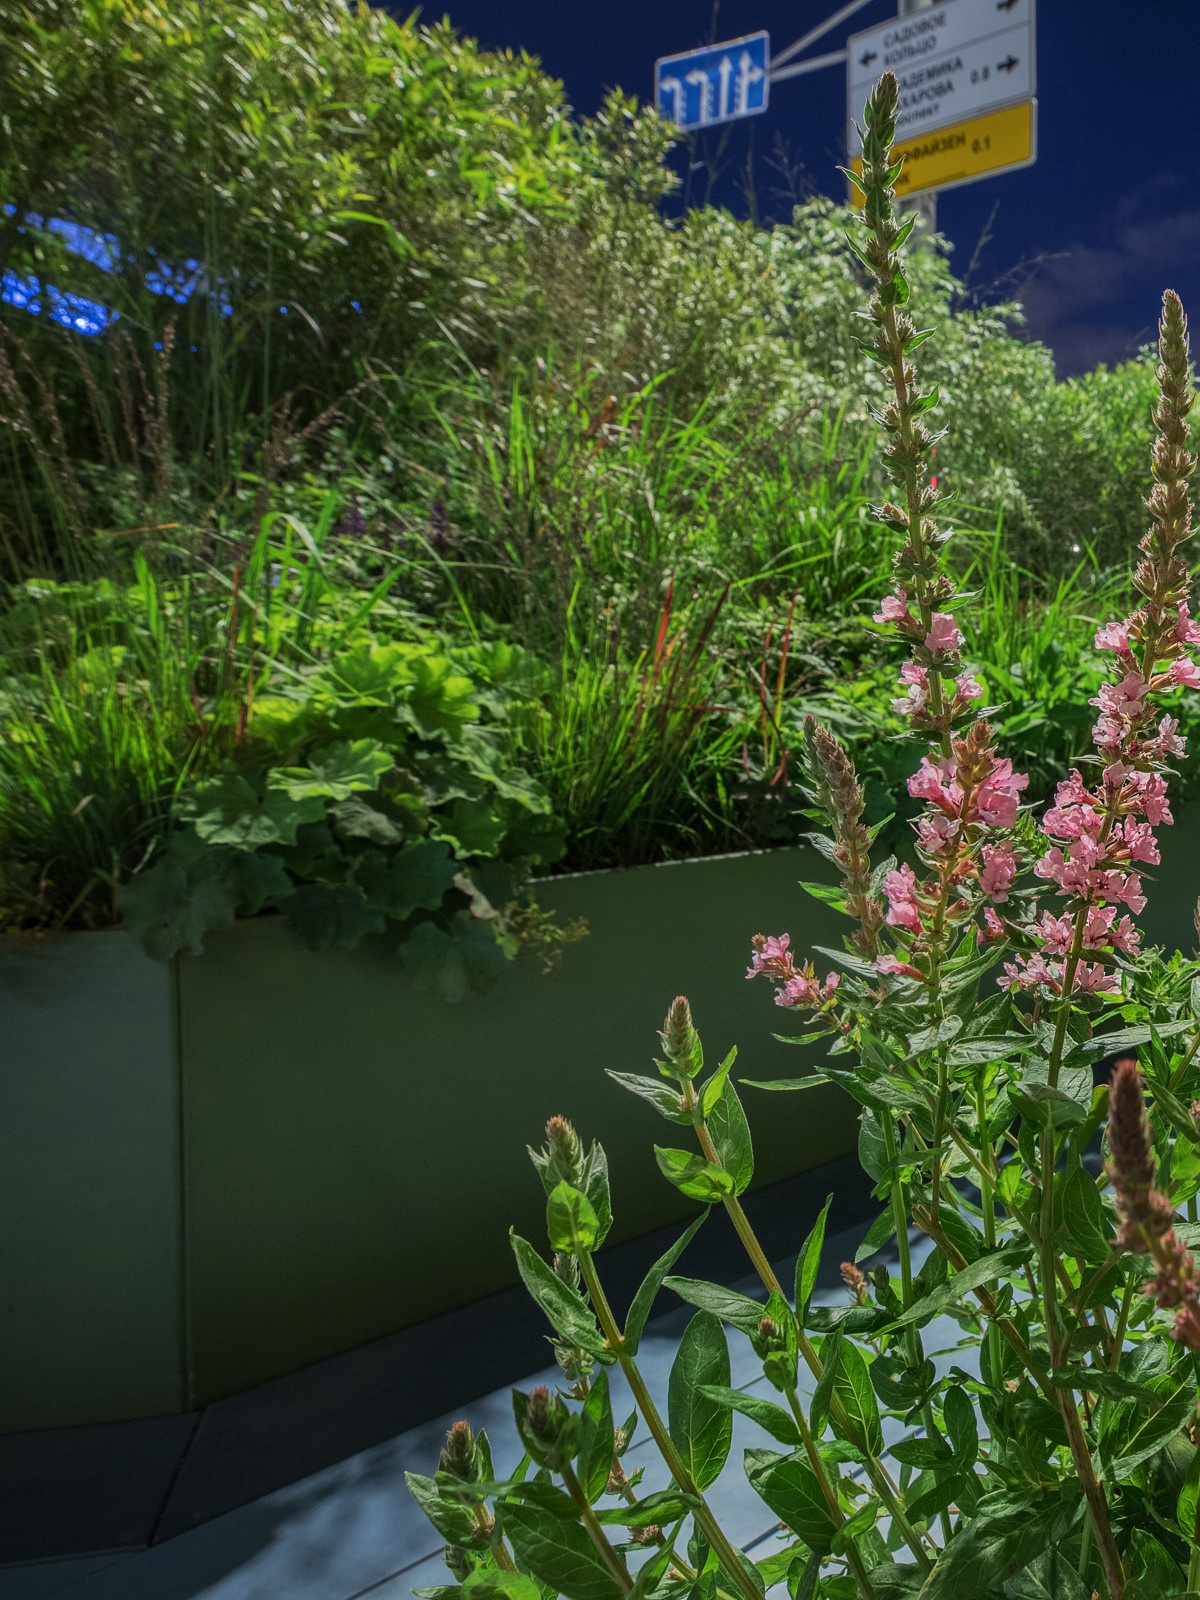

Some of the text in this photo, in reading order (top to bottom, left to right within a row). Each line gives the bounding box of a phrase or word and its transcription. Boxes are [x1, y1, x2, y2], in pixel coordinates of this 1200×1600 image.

[883, 10, 947, 48] САДОВОЕ
[883, 34, 938, 66] КОЛЬЦО
[901, 56, 963, 89] АДЕМИКА
